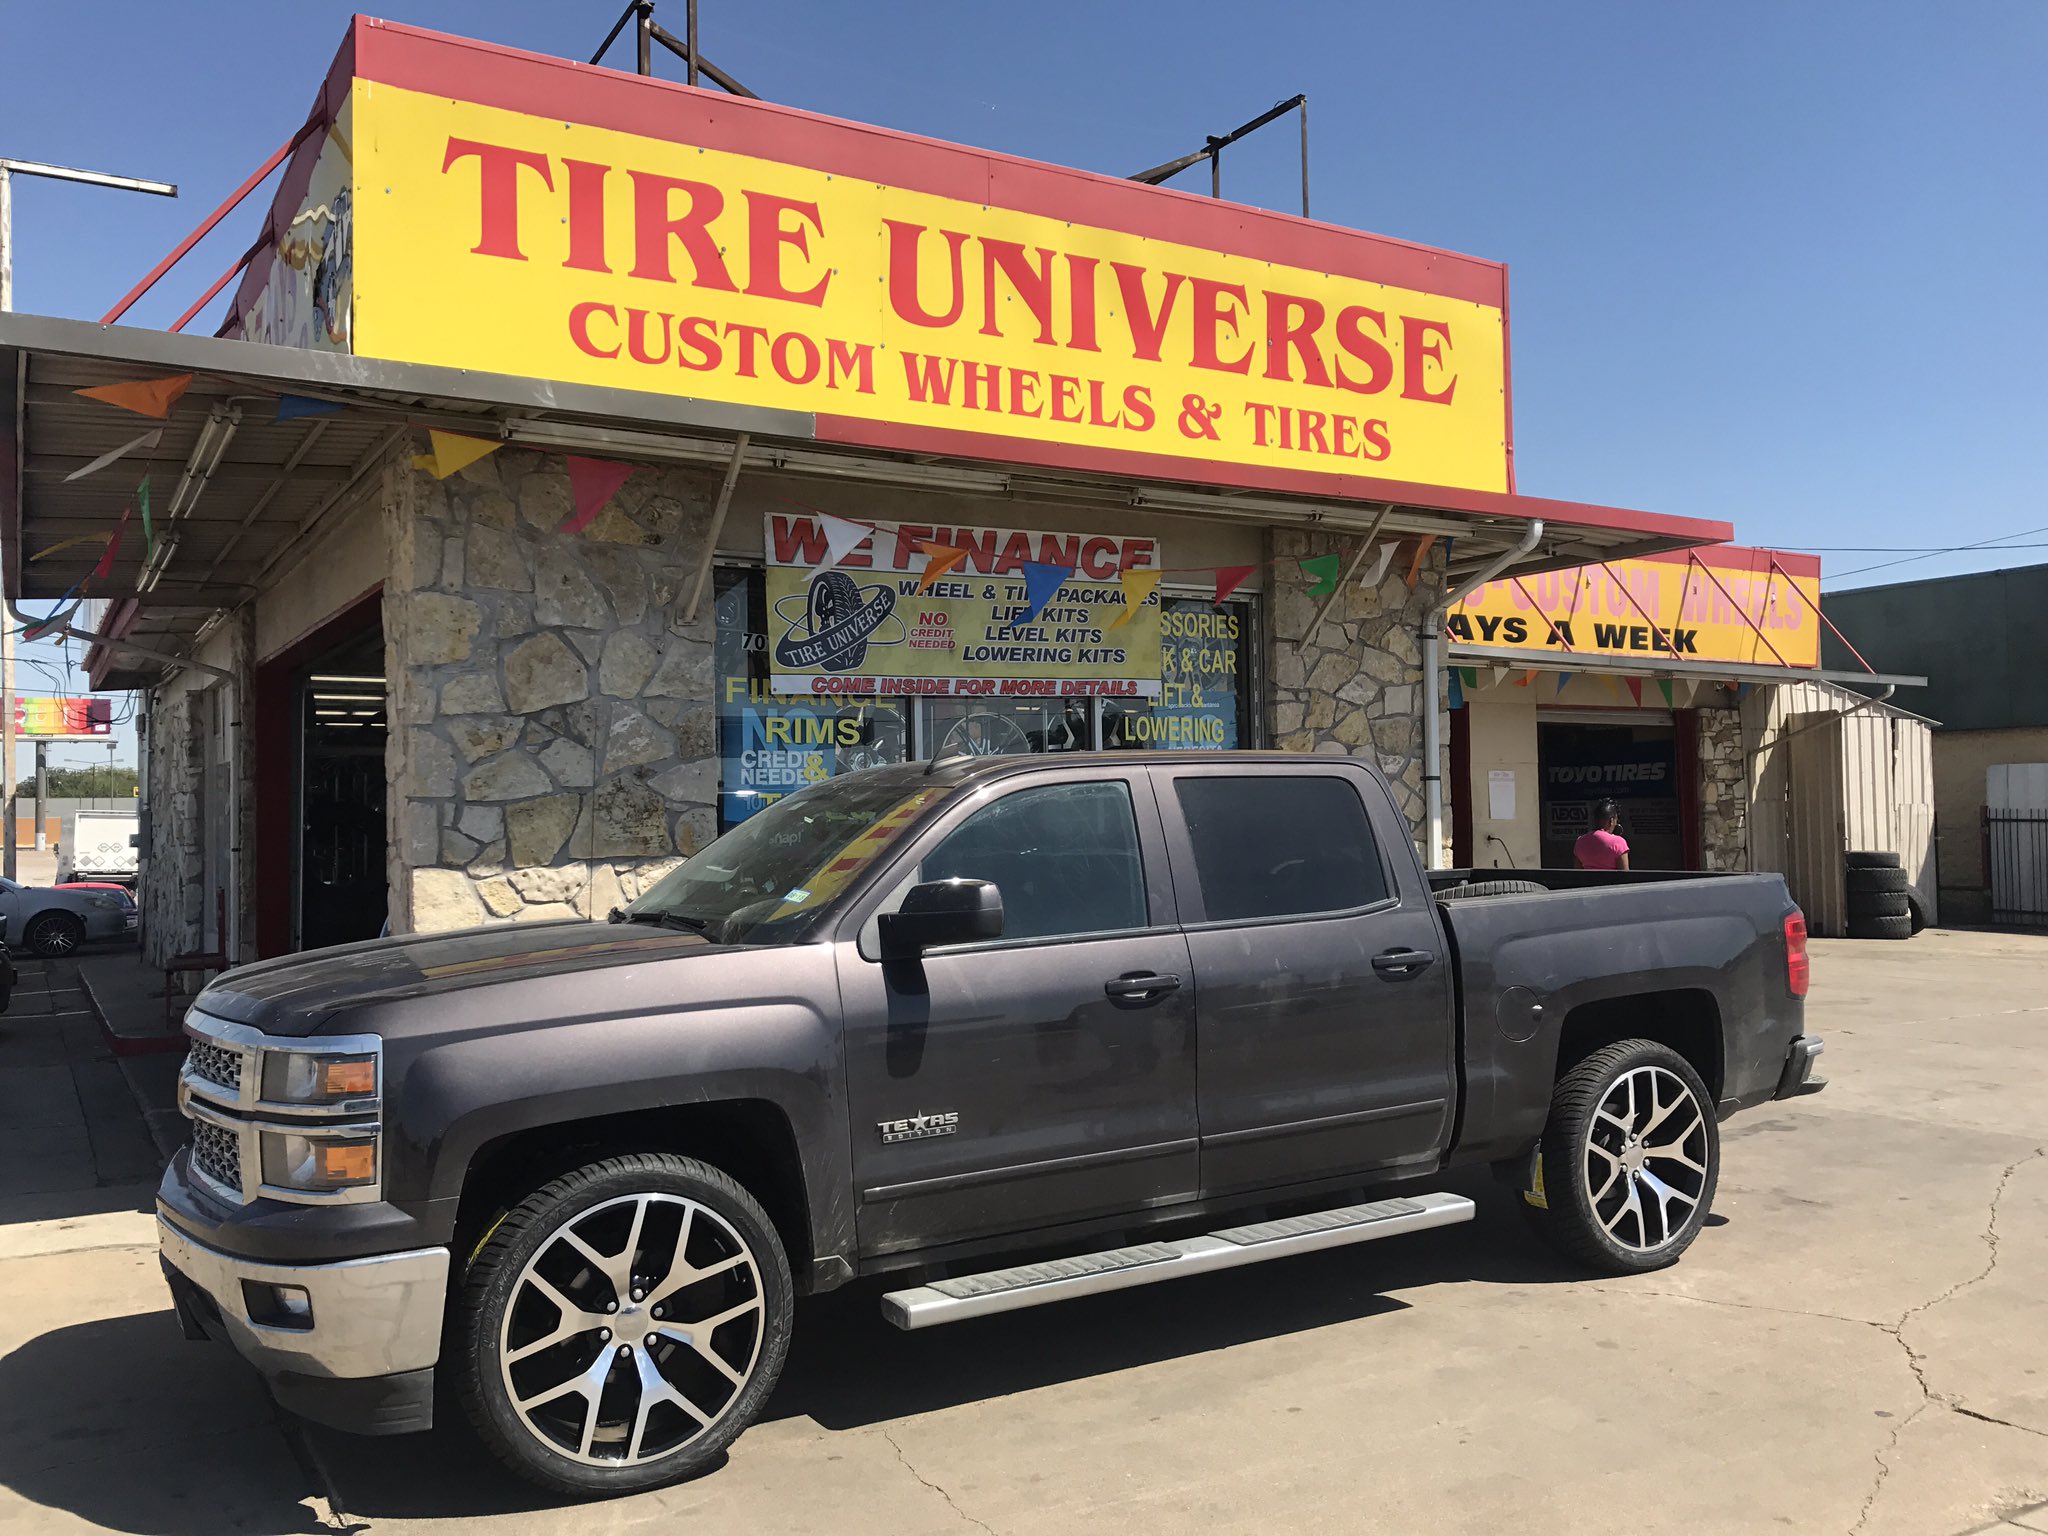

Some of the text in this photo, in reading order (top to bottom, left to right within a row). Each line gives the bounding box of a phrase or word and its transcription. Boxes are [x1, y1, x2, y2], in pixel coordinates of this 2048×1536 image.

[441, 135, 1459, 406] TIRE UNIVERSE
[568, 301, 1393, 462] CUSTOM WHEELS & TIRES
[898, 580, 975, 600] WHEEL
[981, 584, 997, 601] &
[1056, 588, 1160, 607] PACKAS
[1680, 570, 1804, 632] WHEELS
[918, 612, 948, 626] NO
[991, 605, 1090, 624] LIF KITS
[784, 590, 892, 666] TIRE UNIVERSE
[909, 627, 955, 639] CREDIT
[985, 625, 1103, 644] LEVEL KITS
[1448, 613, 1699, 654] AYS A WEEK
[907, 639, 957, 650] NEEDED
[962, 645, 1127, 664] LOWERING KITS
[1181, 647, 1194, 673] &
[1198, 648, 1238, 674] CAR
[811, 677, 1139, 697] COME INSIDE FOR MORE DETAILS
[1191, 683, 1204, 709] &
[765, 716, 862, 746] RIMS
[1124, 715, 1226, 744] LOWERING
[741, 768, 821, 786] NEEDE
[803, 753, 830, 782] &
[1548, 761, 1667, 784] TOYO TIRES
[877, 1109, 959, 1133] TEXAS
[887, 1126, 952, 1141] EDITION
